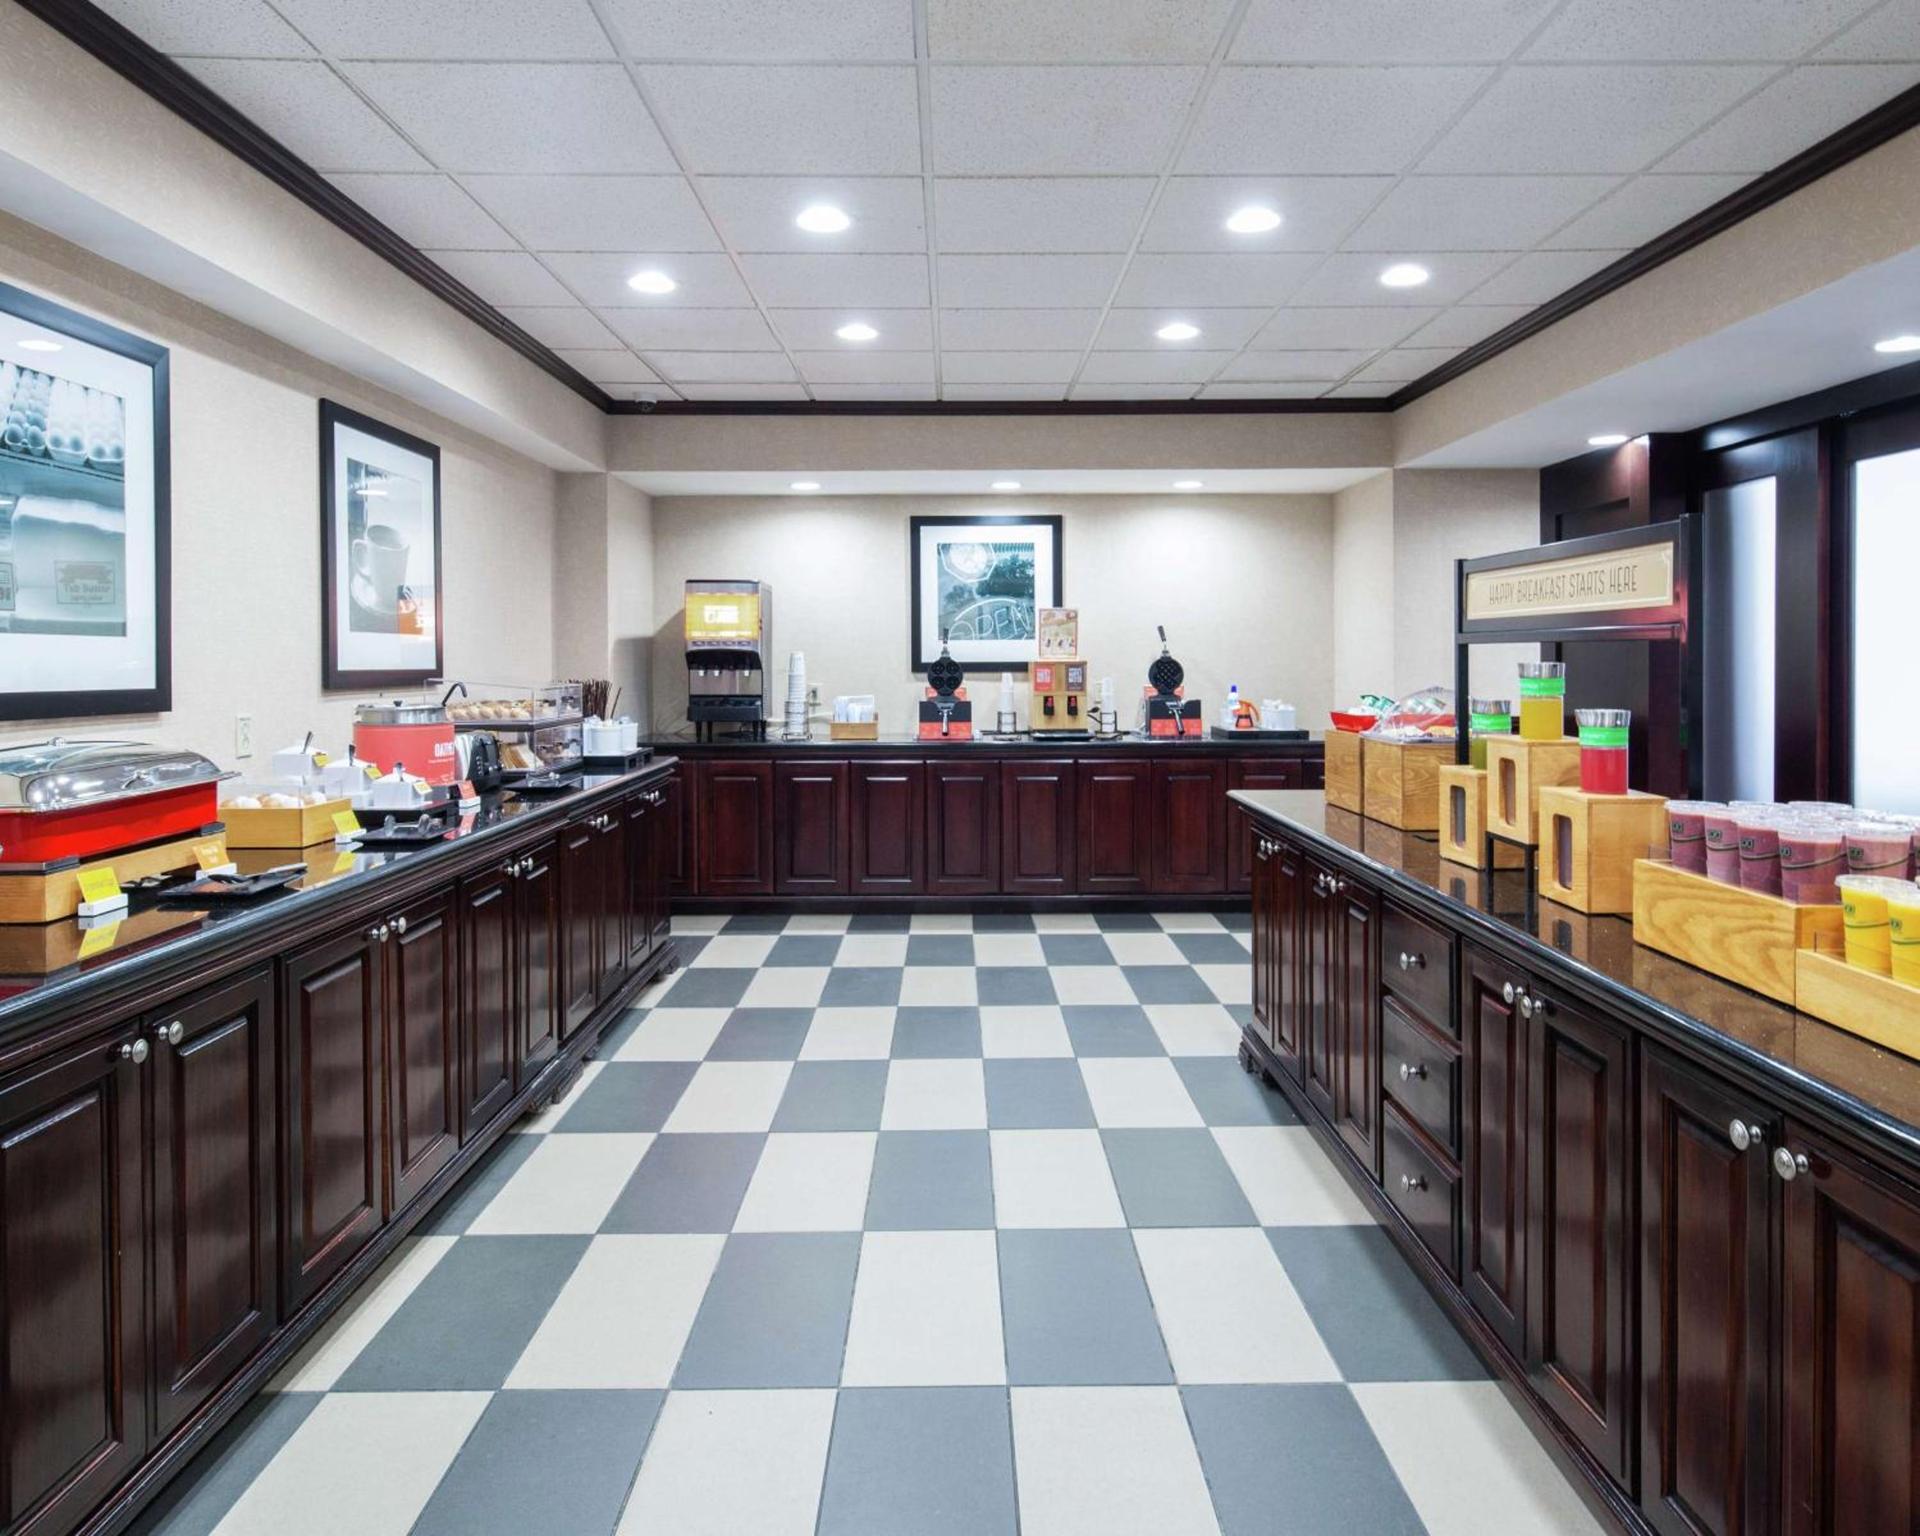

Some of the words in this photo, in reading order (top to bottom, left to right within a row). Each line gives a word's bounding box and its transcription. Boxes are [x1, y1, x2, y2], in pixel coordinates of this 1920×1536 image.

[1489, 582, 1514, 605] HAPPY
[1517, 575, 1566, 603] BREAKFAST
[1568, 570, 1605, 598] STARTS
[1609, 565, 1638, 593] HERE
[948, 602, 1031, 640] OPEN
